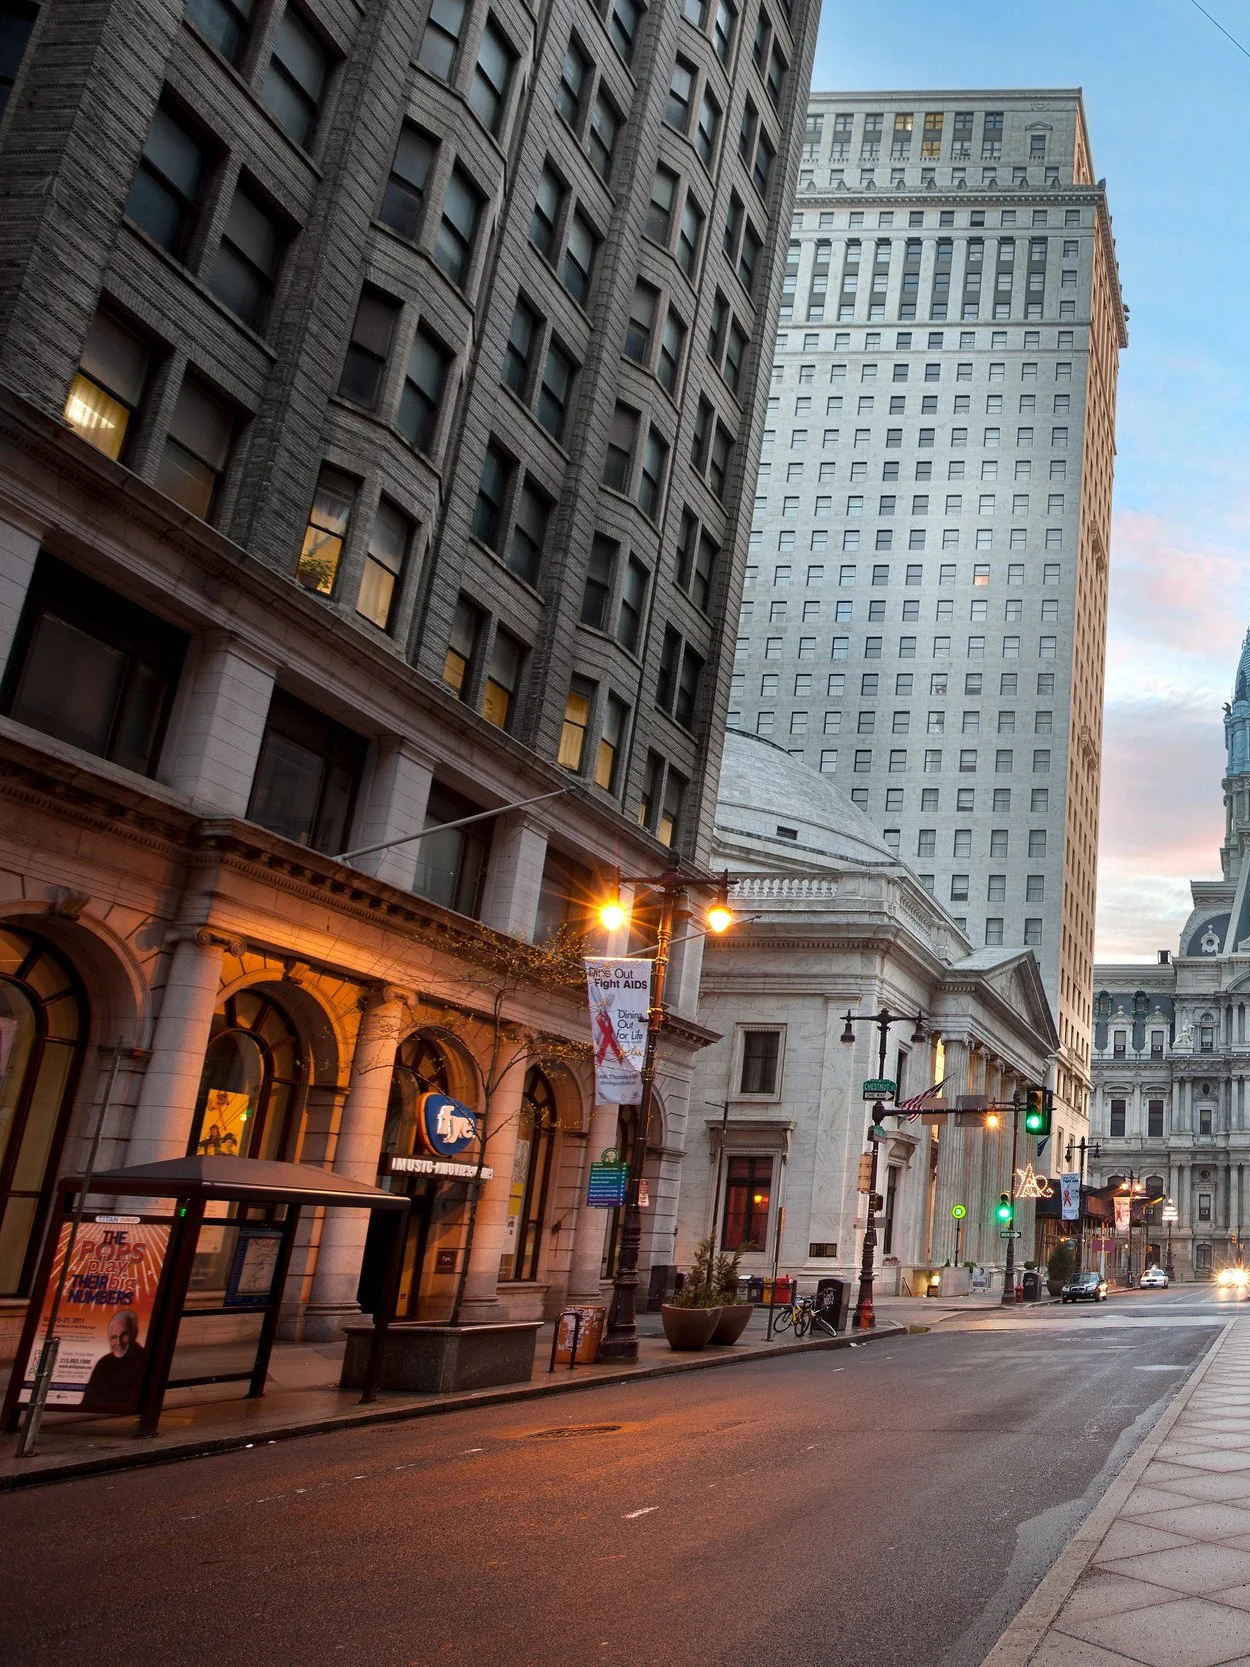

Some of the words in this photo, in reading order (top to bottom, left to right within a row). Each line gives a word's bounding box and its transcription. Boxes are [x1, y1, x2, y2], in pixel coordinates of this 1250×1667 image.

[614, 968, 634, 979] Out
[594, 979, 621, 990] Fight
[622, 980, 648, 990] AIDS
[617, 1020, 635, 1029] Out
[616, 1029, 630, 1040] for
[631, 1030, 644, 1040] Life
[103, 1230, 128, 1245] THE
[79, 1240, 146, 1265] POPS
[88, 1255, 130, 1281] play
[71, 1274, 108, 1291] THEIR
[107, 1271, 138, 1294] big
[67, 1289, 134, 1306] NUMBERS
